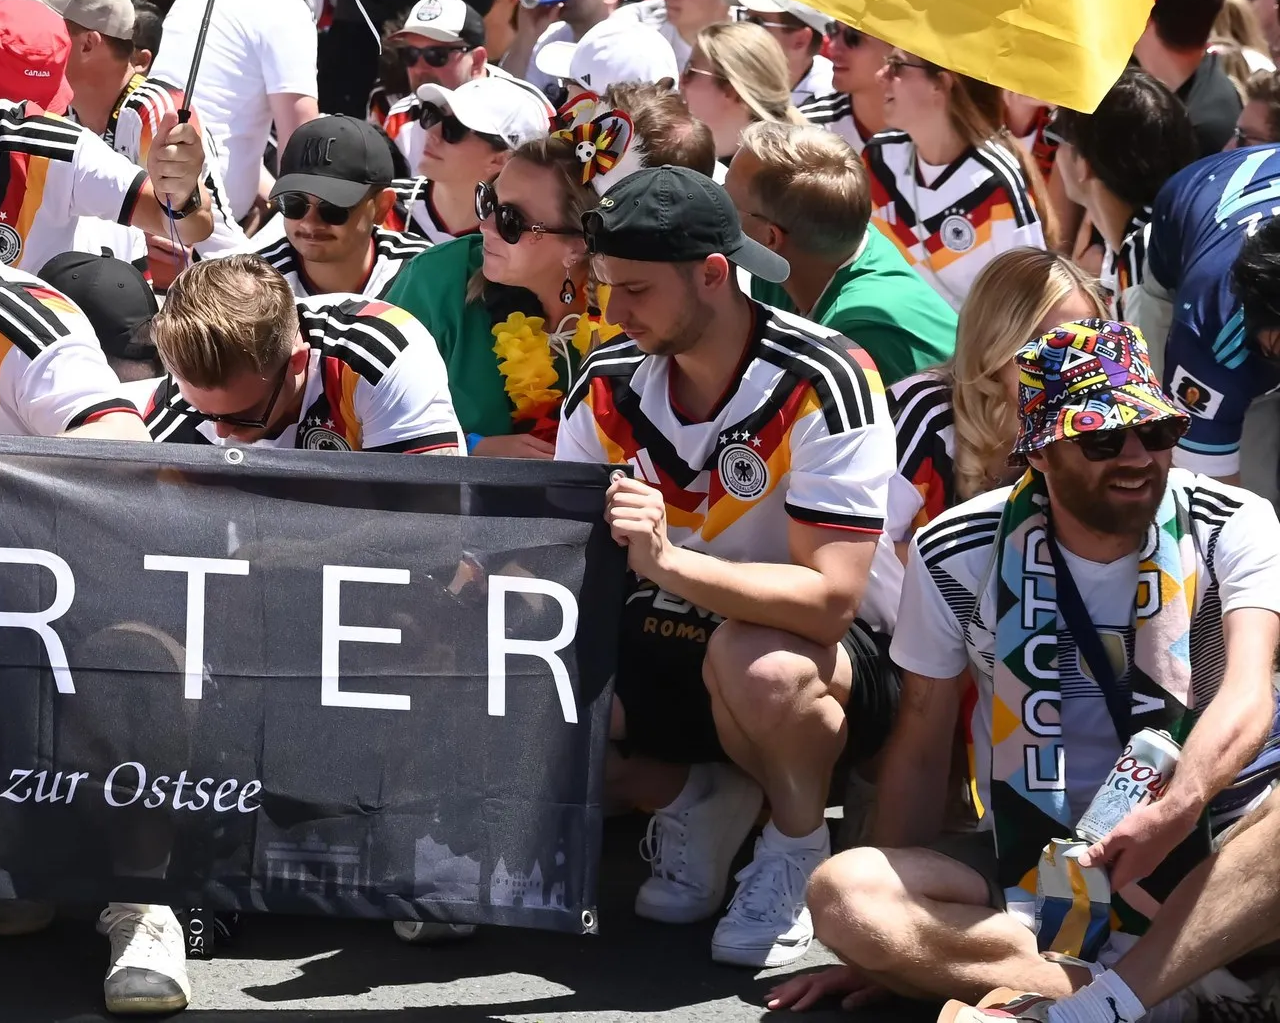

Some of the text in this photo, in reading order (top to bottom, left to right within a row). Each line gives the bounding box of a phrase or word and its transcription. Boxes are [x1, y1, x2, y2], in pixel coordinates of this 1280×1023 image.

[643, 617, 706, 643] ROMA
[0, 767, 91, 805] zur
[104, 761, 263, 813] Ostsee
